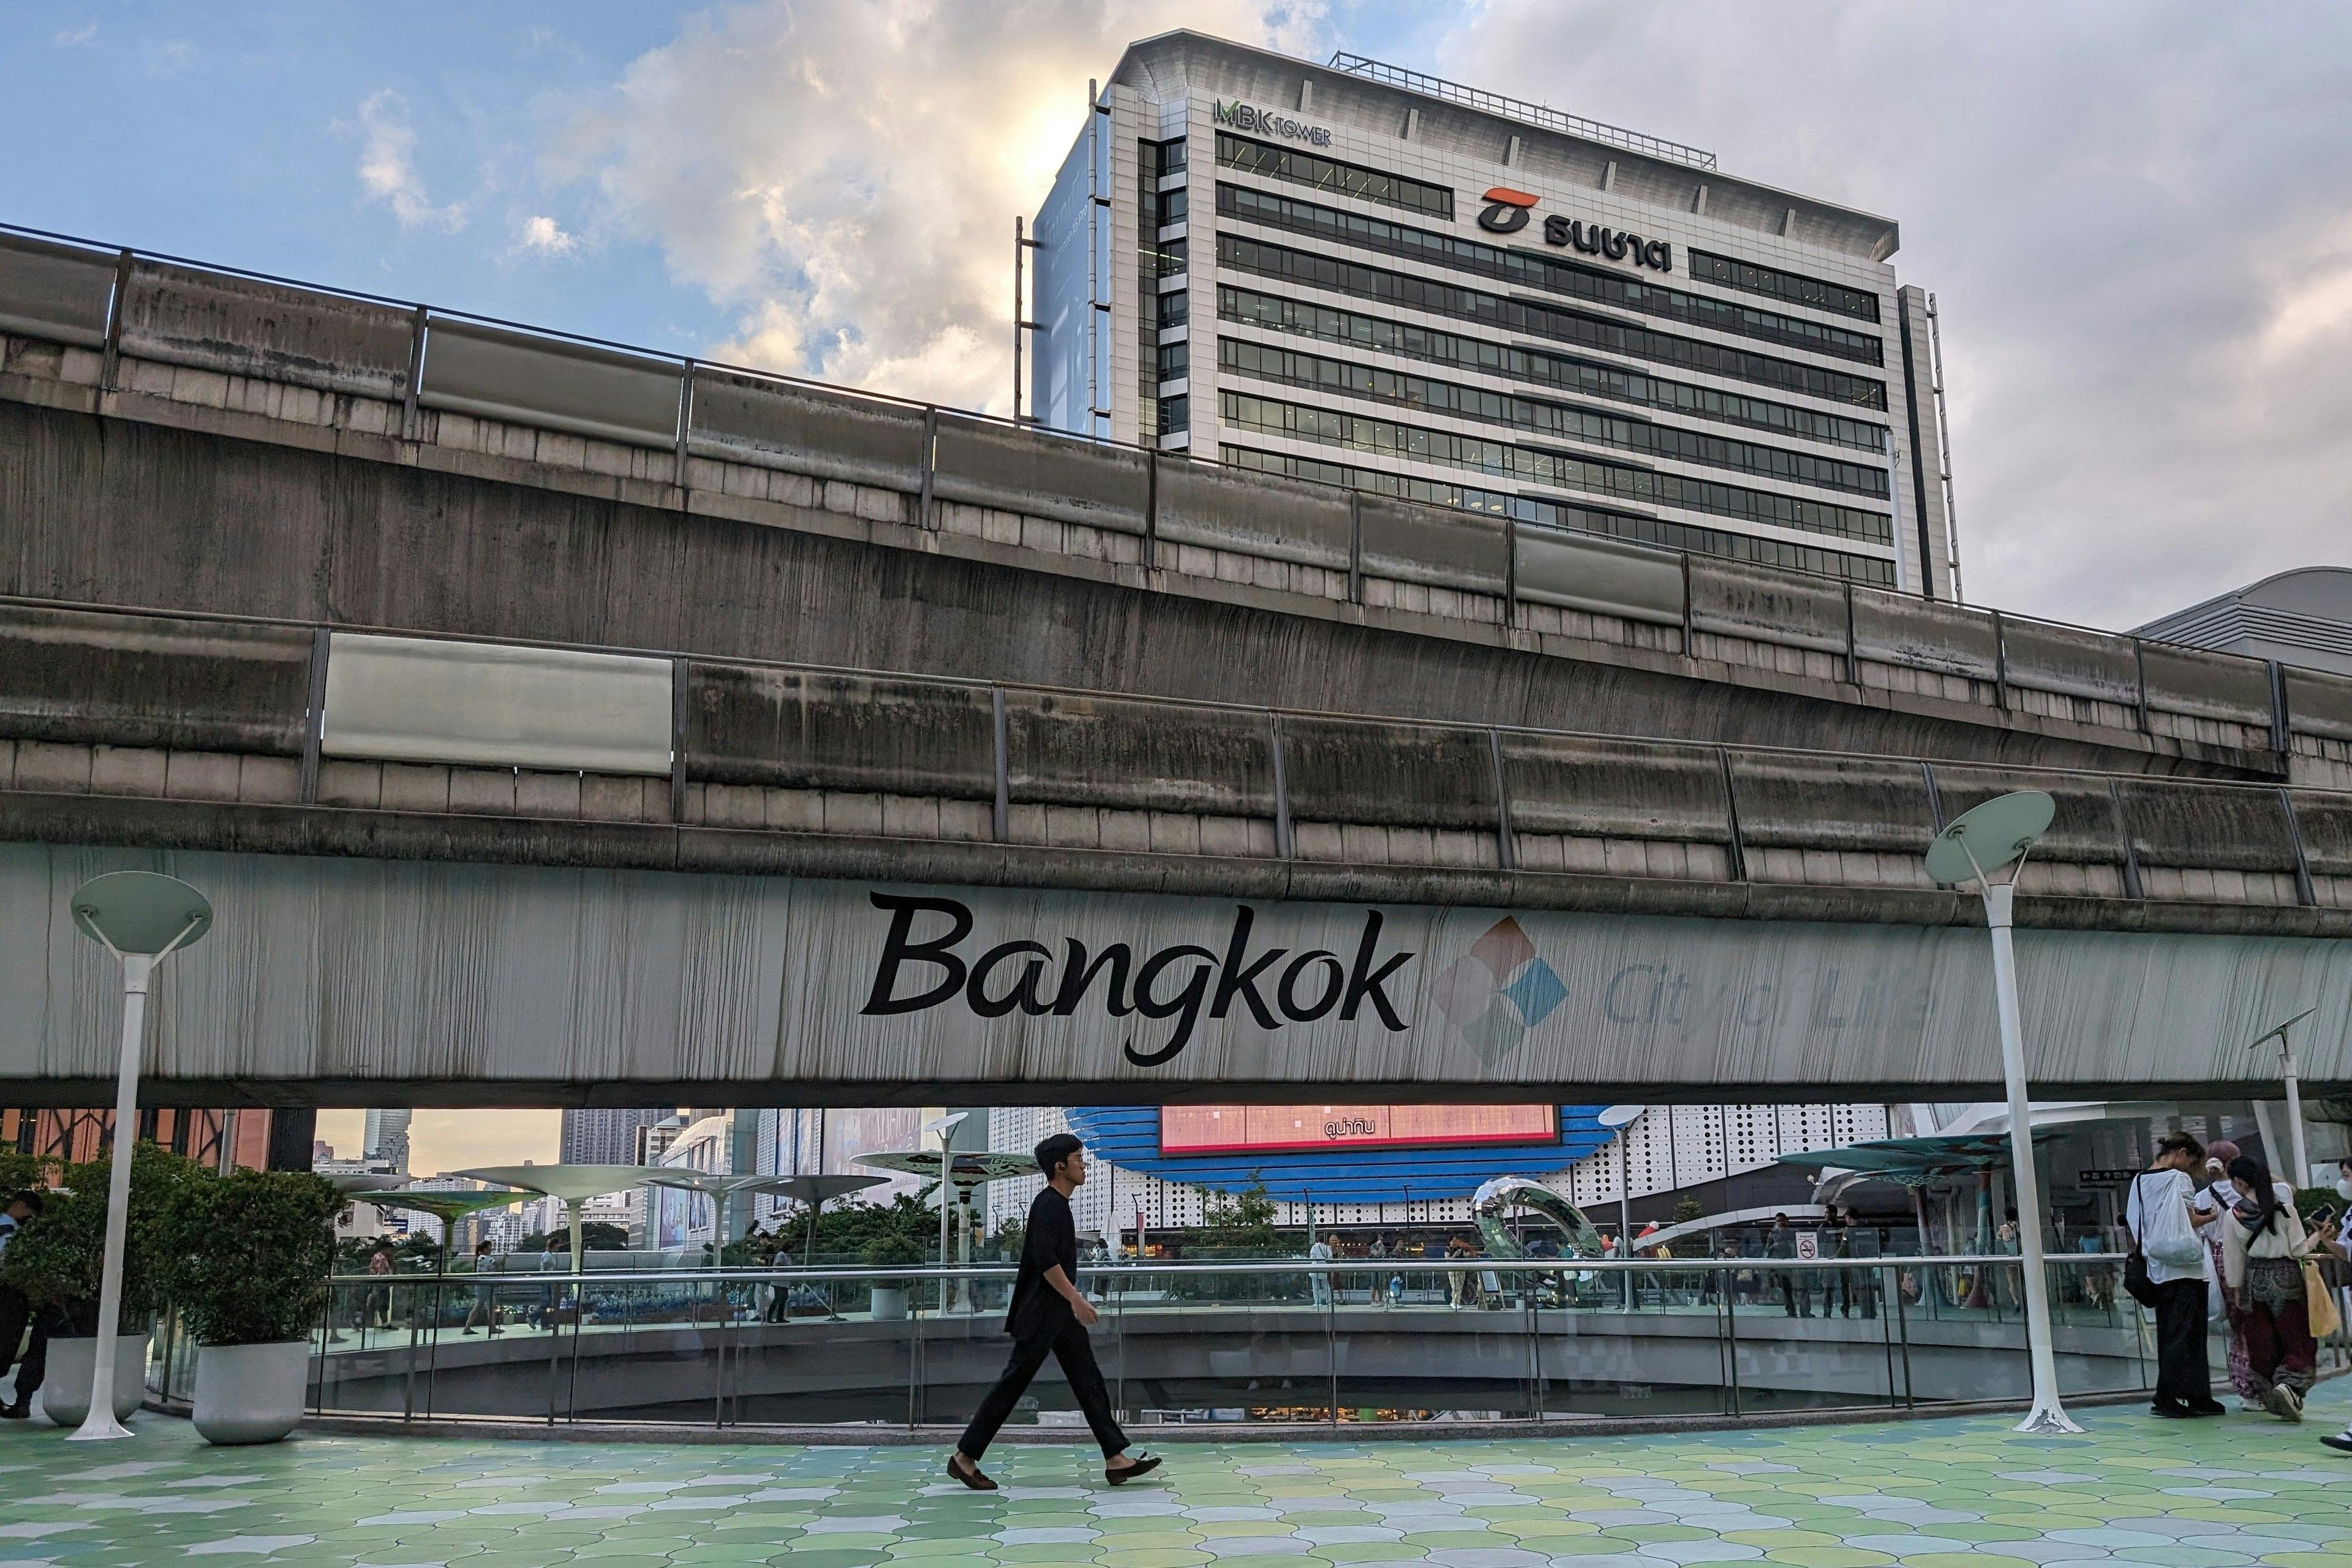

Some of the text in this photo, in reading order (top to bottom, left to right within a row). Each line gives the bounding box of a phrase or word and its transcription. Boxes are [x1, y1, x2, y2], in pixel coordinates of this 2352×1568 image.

[1215, 97, 1333, 146] MBK TOWER
[1545, 214, 1672, 271] ธนชาต
[859, 890, 1416, 1068] Bangkok
[1325, 1117, 1374, 1139] ดูน่ากิน
